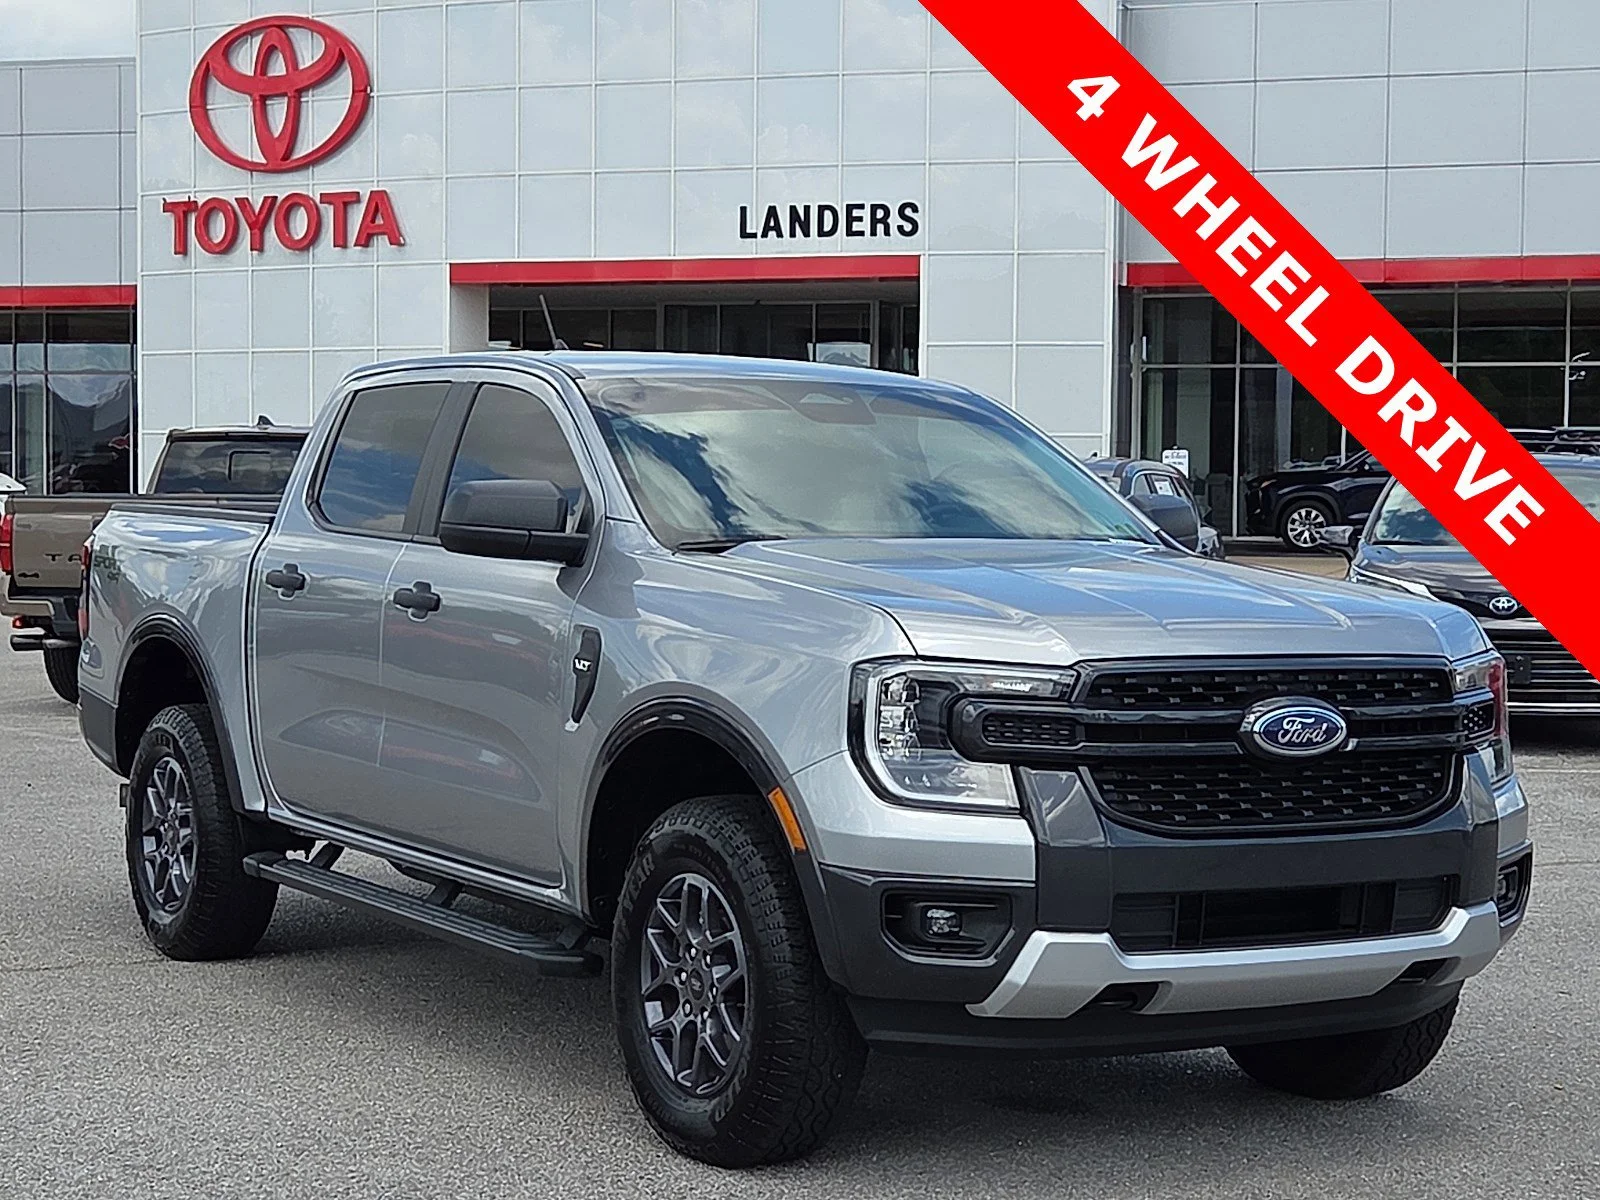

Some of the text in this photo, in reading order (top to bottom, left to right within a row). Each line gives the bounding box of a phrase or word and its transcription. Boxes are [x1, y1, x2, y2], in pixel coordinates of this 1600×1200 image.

[163, 190, 405, 256] TOYOTA
[739, 202, 919, 239] LANDERS
[1278, 717, 1329, 743] Ford
